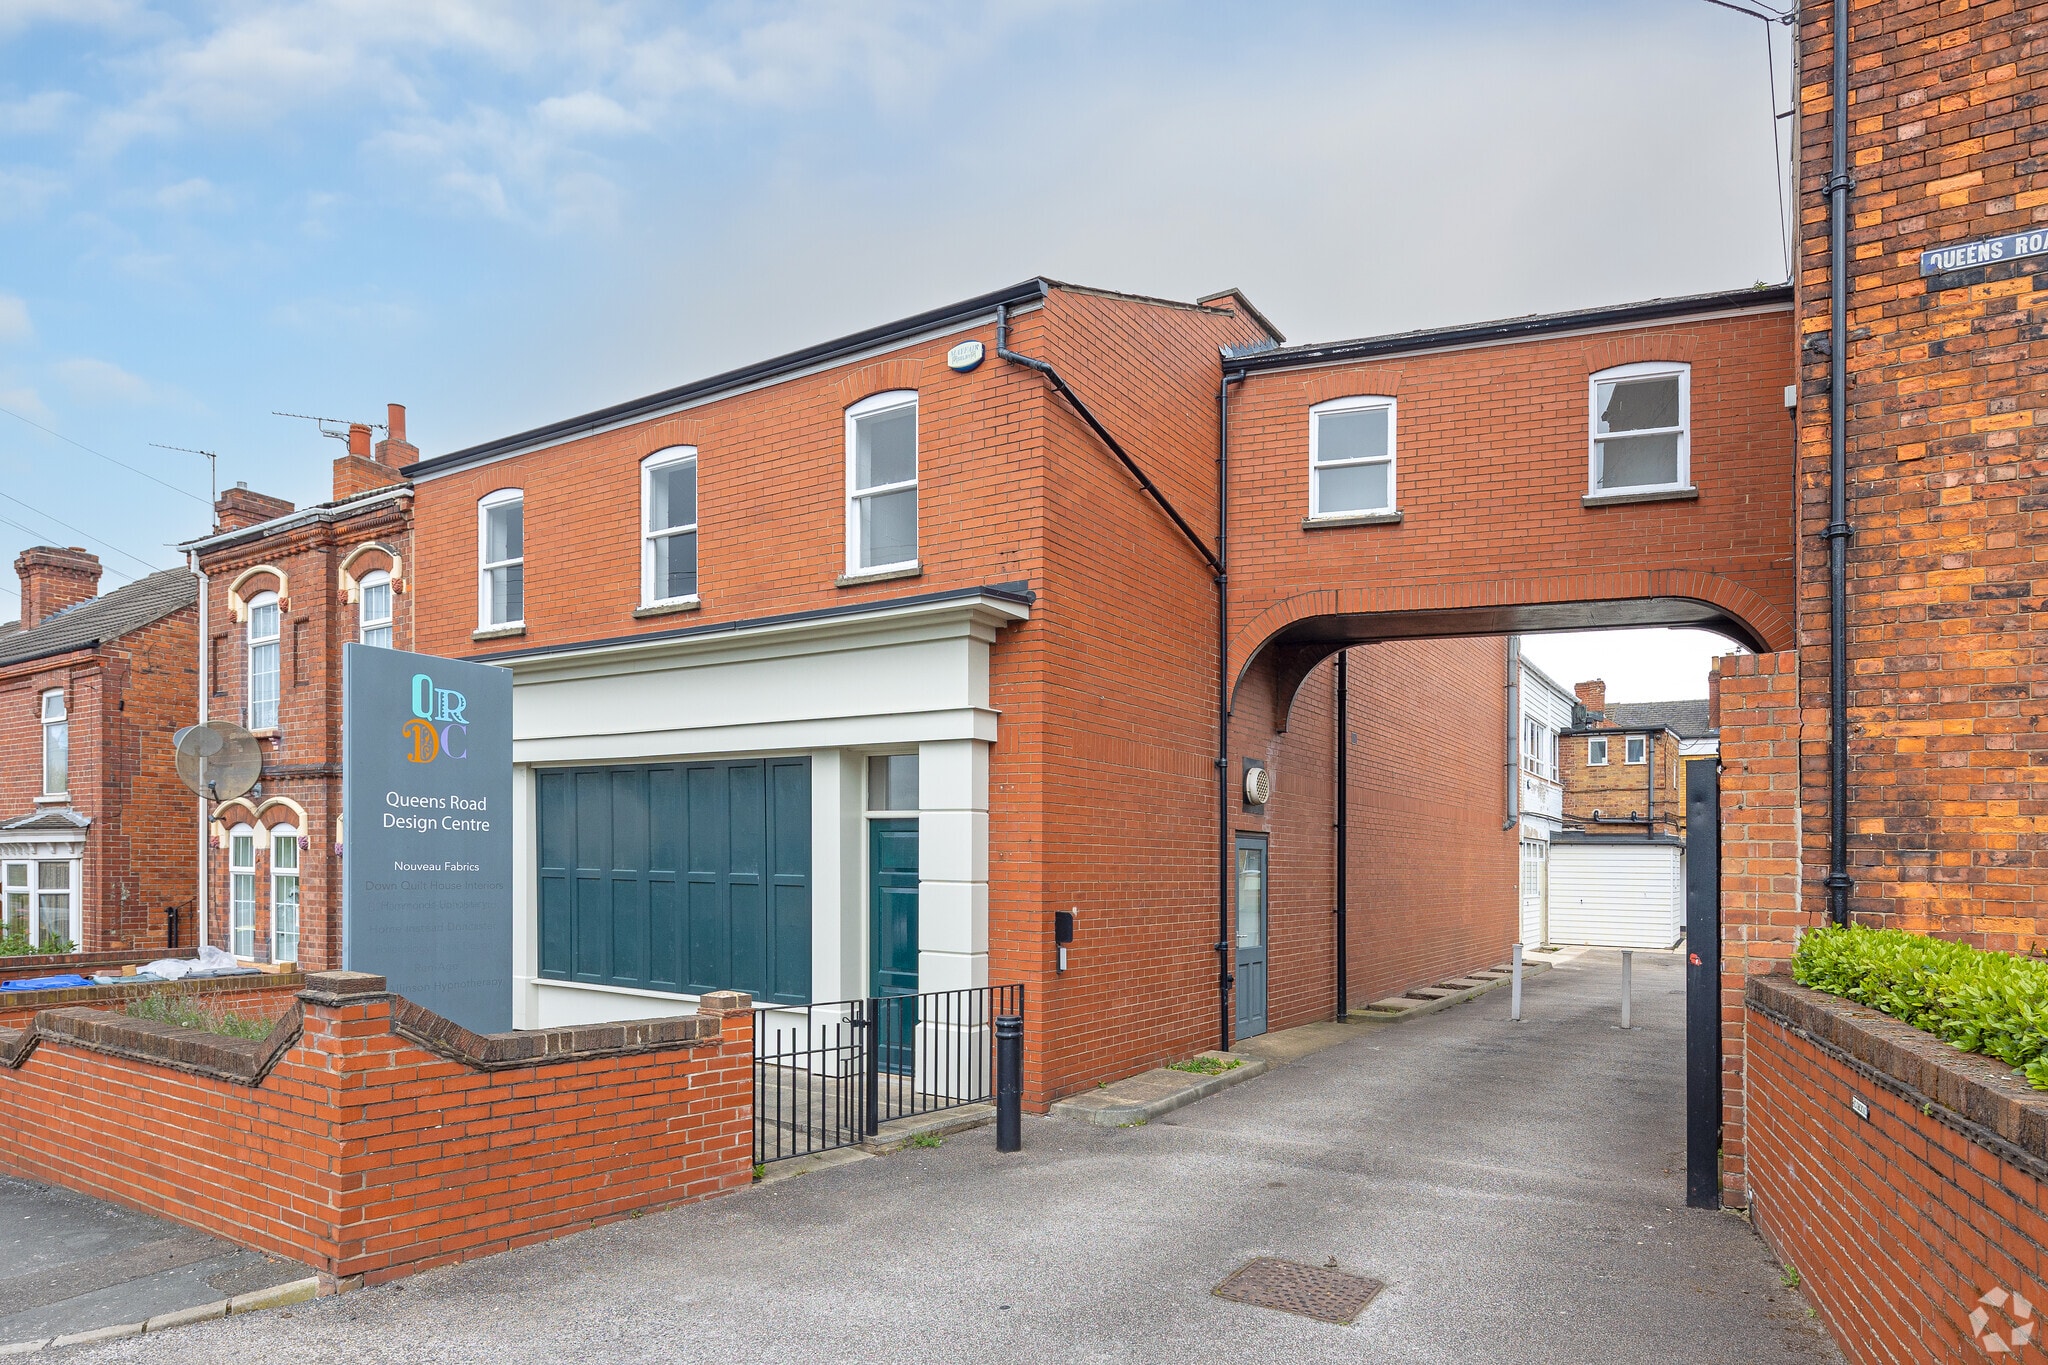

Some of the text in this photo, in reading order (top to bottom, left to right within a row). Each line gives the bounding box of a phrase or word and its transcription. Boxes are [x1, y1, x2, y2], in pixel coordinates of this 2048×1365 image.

[1930, 242, 2003, 270] QUEENS
[386, 791, 487, 811] Queens Road
[383, 813, 490, 833] Design Centre
[394, 861, 480, 872] Nouveau Fabrics
[365, 880, 504, 891] Down Quilt House Interiors
[434, 978, 504, 992] Hypnotherapy
